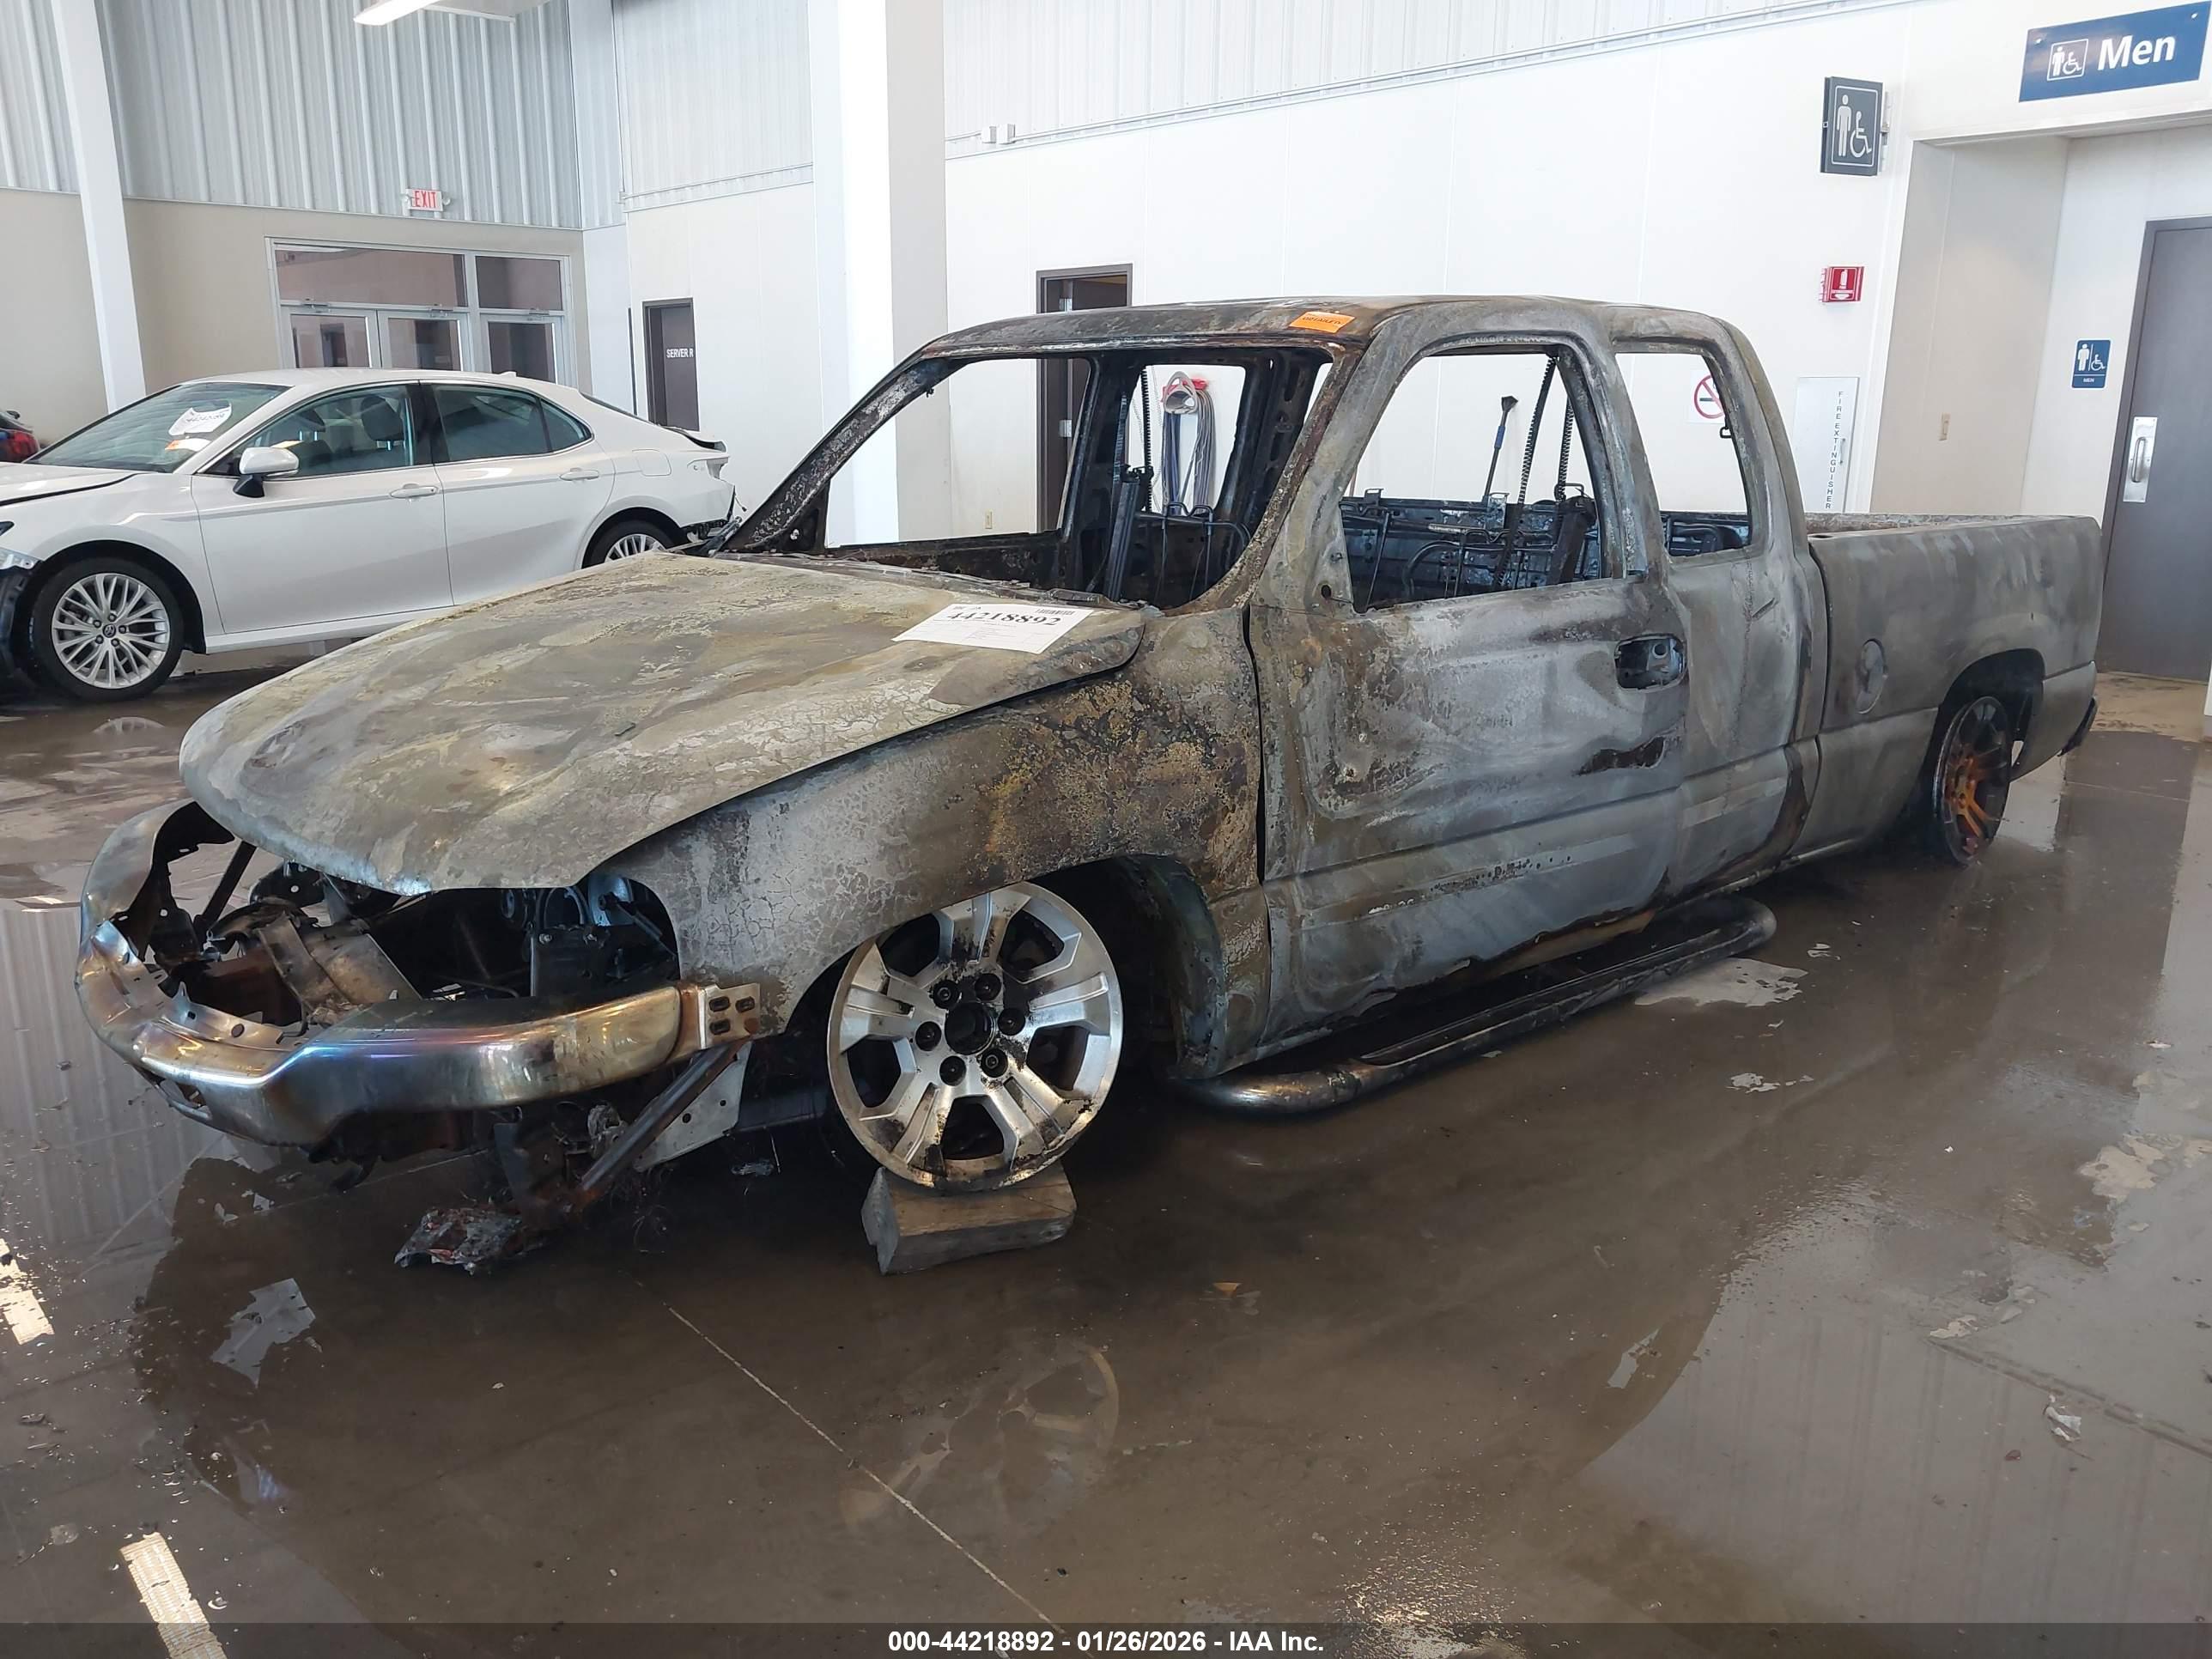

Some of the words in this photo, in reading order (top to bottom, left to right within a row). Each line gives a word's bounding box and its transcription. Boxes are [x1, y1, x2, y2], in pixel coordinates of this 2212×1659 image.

[2097, 34, 2176, 70] Men
[414, 190, 436, 209] EXIT
[666, 348, 689, 358] SERVER
[1836, 391, 1844, 420] FIRE
[1825, 422, 1840, 509] EXTINGUISHER
[947, 611, 1061, 626] 44218892
